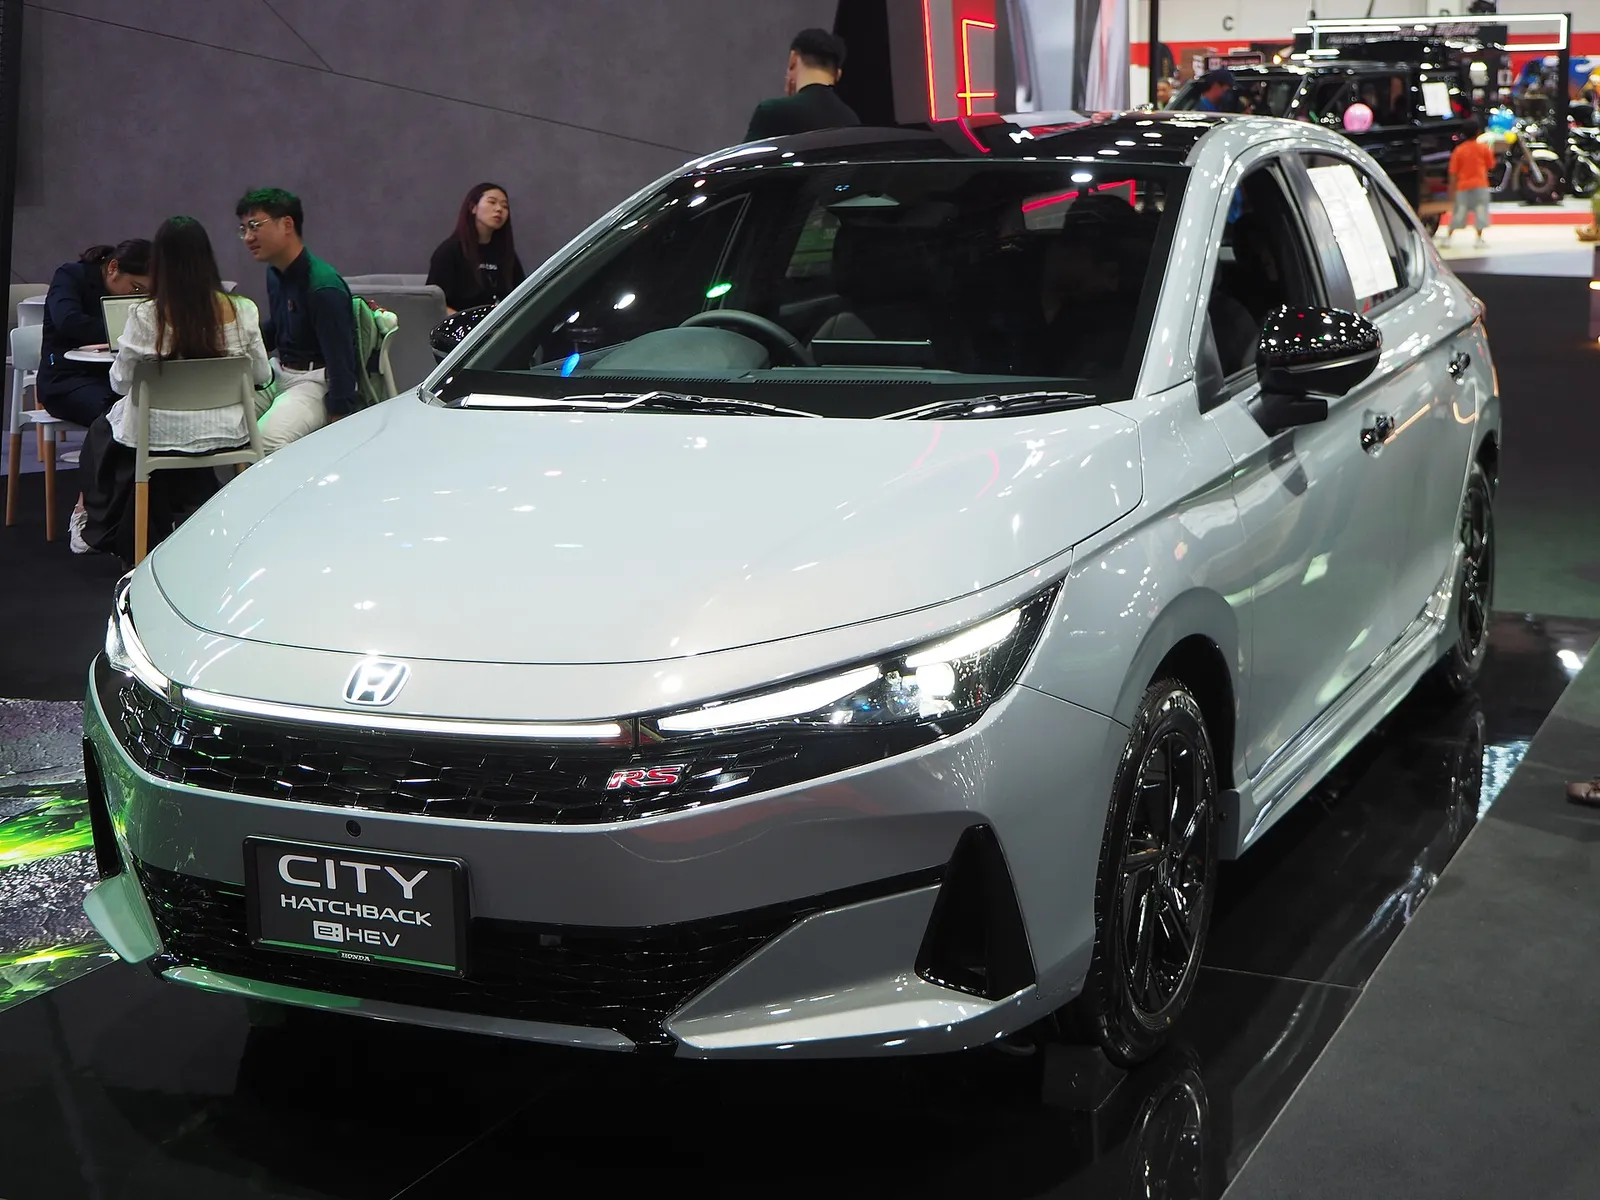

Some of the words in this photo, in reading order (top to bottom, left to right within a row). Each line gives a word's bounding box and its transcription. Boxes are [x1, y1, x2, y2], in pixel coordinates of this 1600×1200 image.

[1222, 15, 1234, 32] C
[605, 764, 684, 790] RS
[278, 854, 429, 900] CITY
[280, 893, 433, 927] HATCHBACK
[341, 952, 371, 962] HONDA
